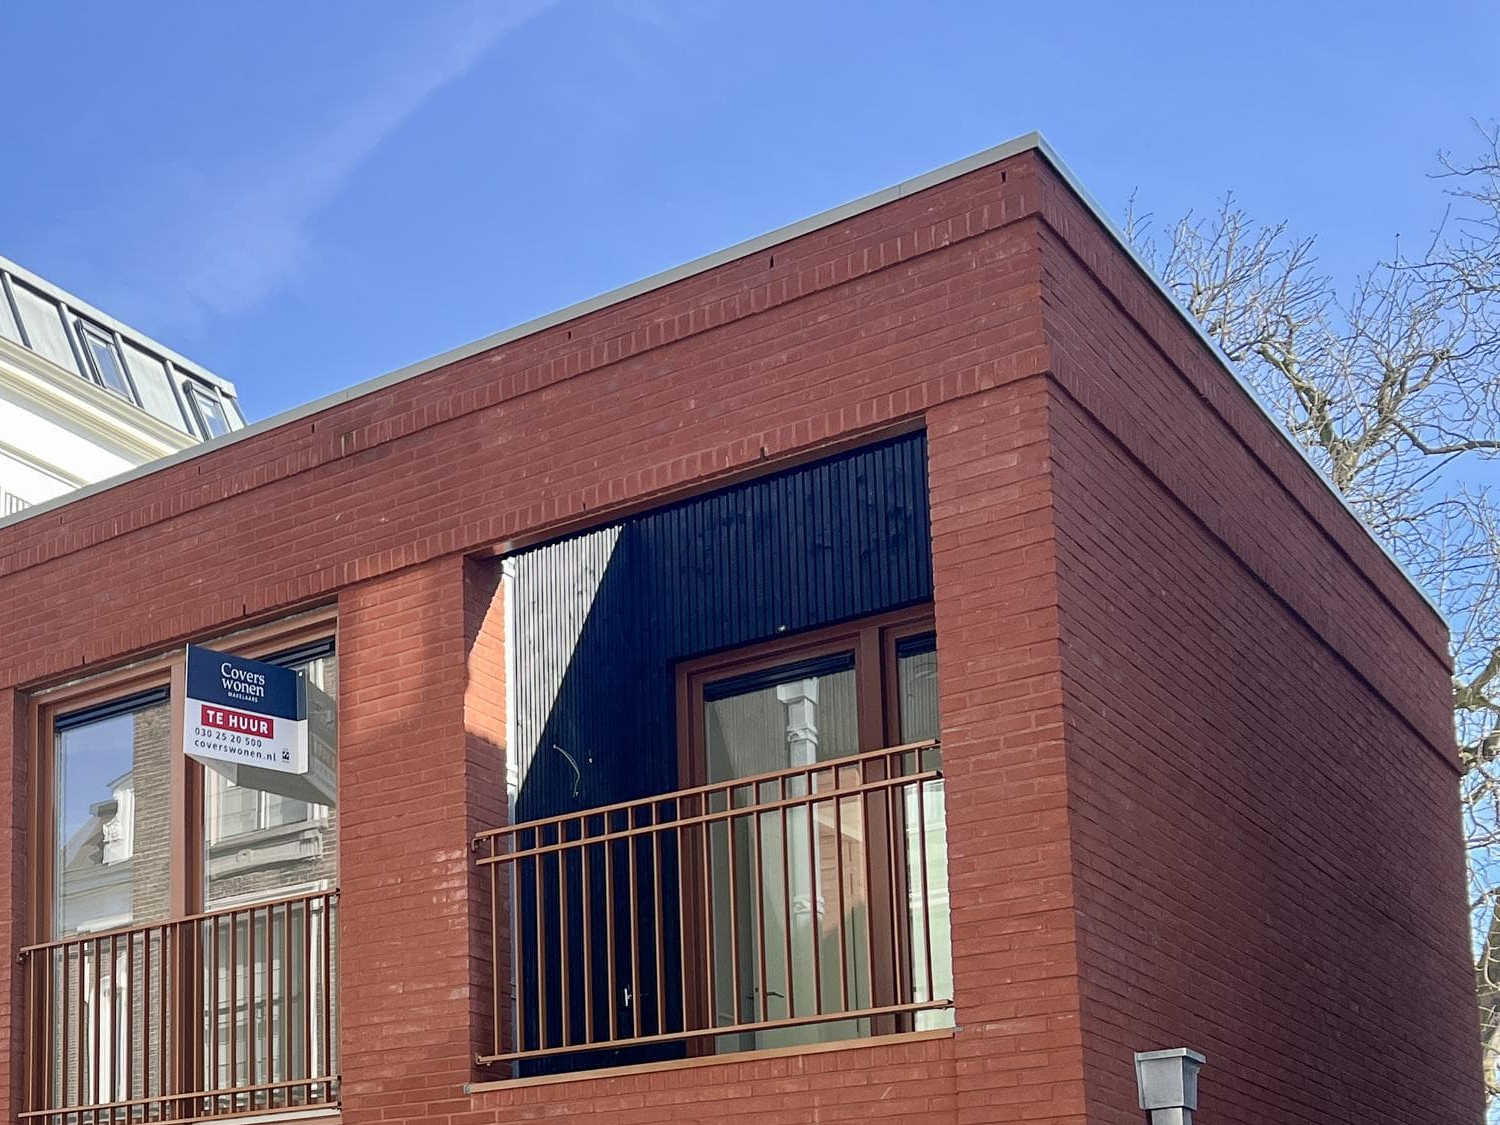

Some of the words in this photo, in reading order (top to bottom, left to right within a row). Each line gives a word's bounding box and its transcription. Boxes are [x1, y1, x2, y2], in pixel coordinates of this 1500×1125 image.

[221, 662, 265, 685] Covers
[222, 678, 264, 697] wonen
[206, 709, 224, 725] TE
[228, 715, 269, 734] HUUR
[194, 727, 212, 738] 030
[215, 732, 227, 741] 25
[230, 735, 242, 744] 20
[245, 737, 262, 748] 500
[194, 739, 277, 761] coverswonen.nl
